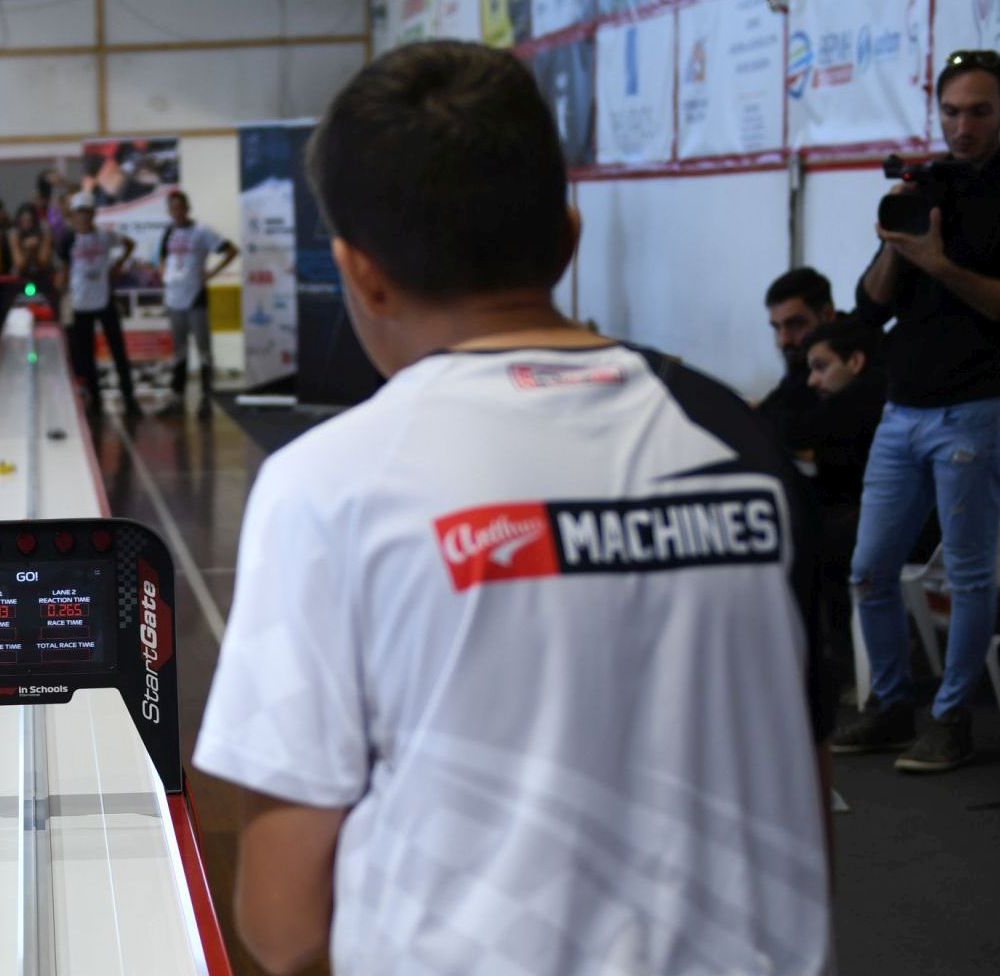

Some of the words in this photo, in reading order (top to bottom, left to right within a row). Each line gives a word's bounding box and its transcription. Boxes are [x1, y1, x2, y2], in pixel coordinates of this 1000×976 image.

[557, 501, 780, 565] MACHINES
[16, 571, 38, 582] GO!
[47, 604, 82, 616] 0.265
[140, 580, 160, 724] StartGate
[29, 684, 69, 694] Schools
